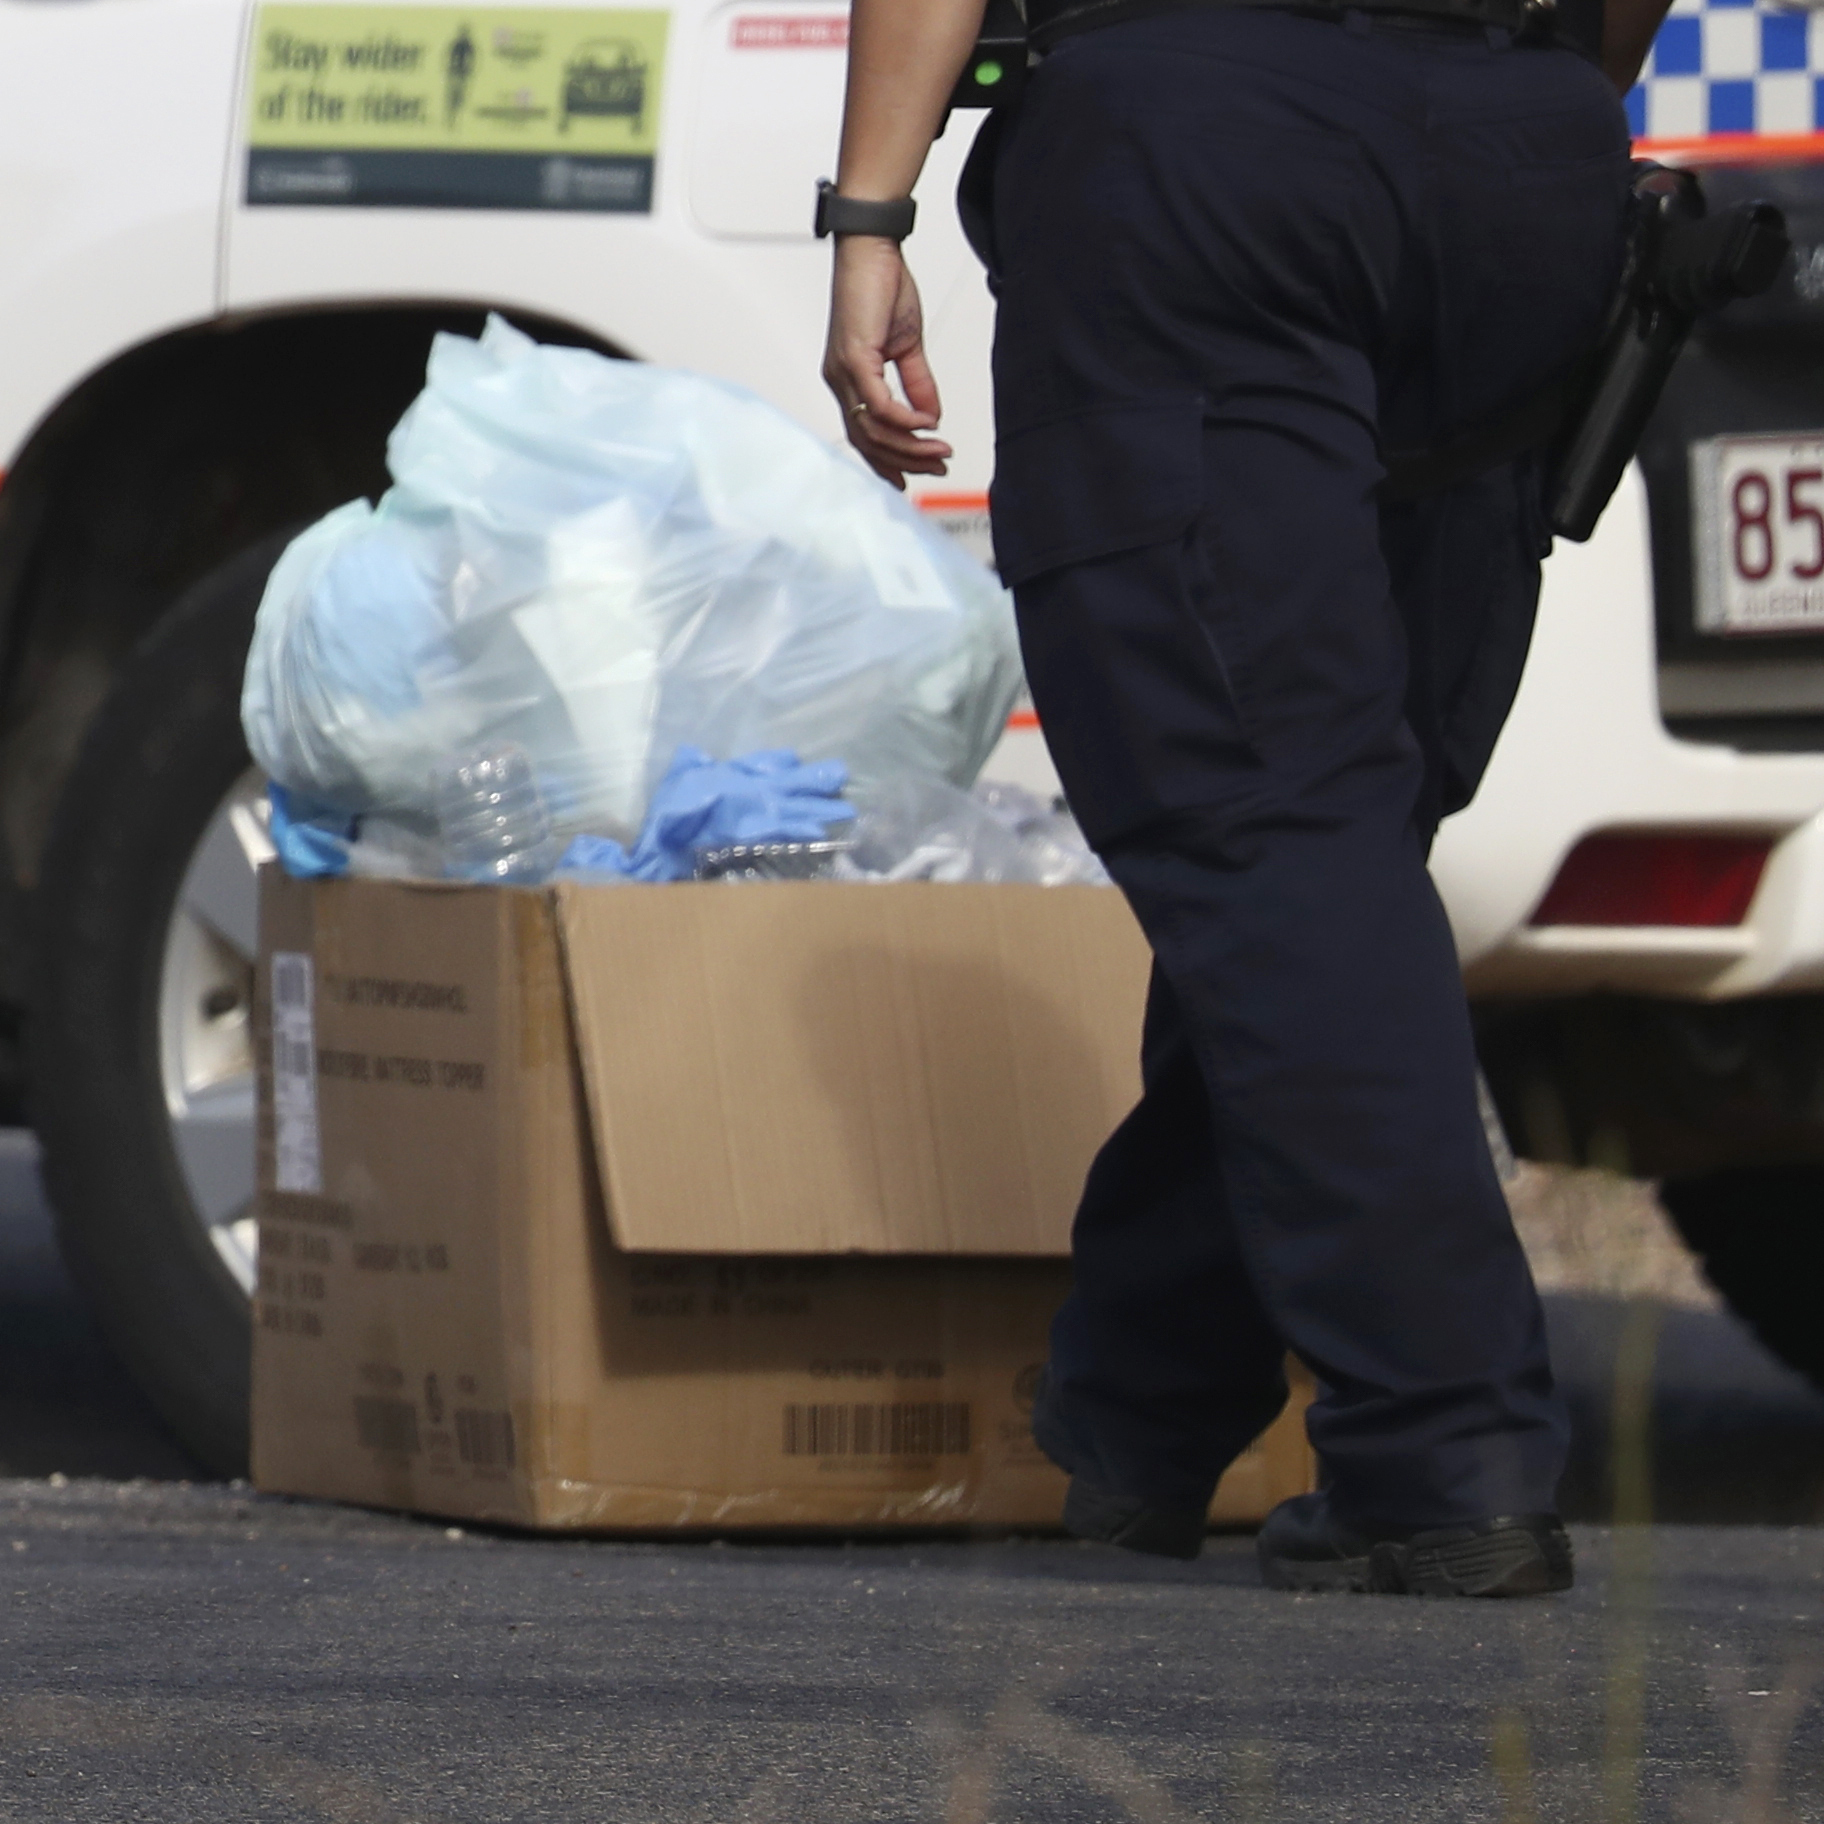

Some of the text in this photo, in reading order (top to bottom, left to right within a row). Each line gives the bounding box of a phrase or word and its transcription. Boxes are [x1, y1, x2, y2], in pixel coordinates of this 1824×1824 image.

[264, 29, 424, 74] Stay wider
[259, 81, 290, 122] of
[297, 87, 345, 124] the
